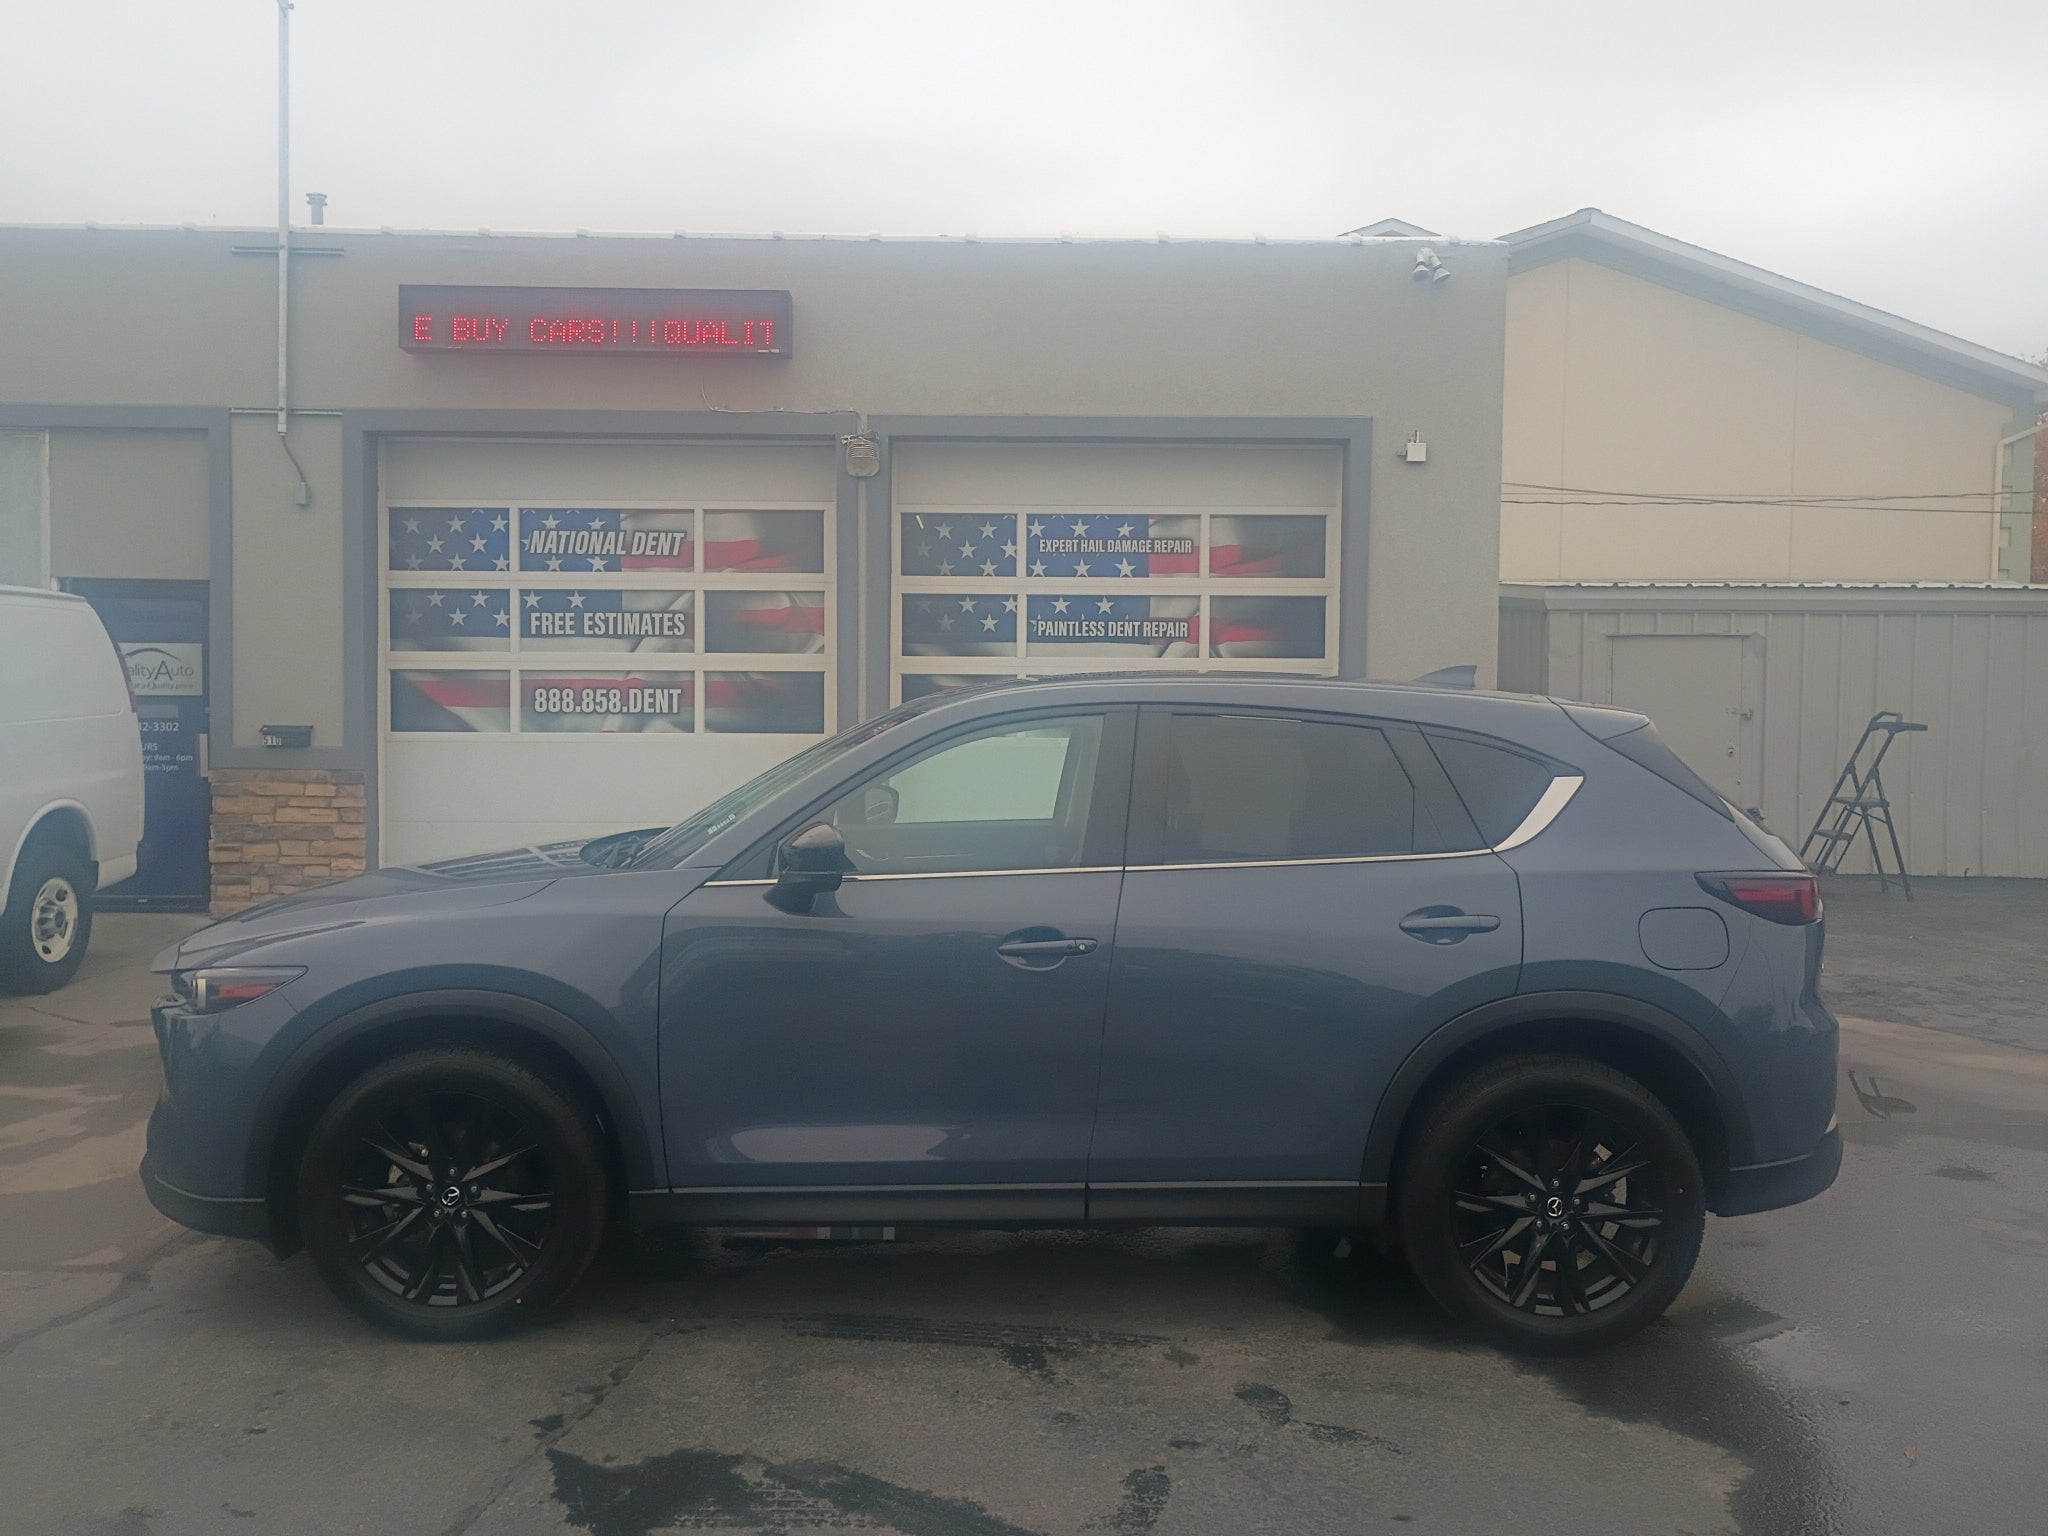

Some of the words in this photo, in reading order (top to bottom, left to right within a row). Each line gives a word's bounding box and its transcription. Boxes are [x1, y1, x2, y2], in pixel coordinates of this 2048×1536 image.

[414, 316, 432, 341] E
[452, 317, 509, 342] BUY
[530, 530, 627, 555] NATIONAL
[630, 532, 685, 556] DENT
[1039, 539, 1078, 553] EXPERT
[1081, 540, 1105, 553] HAIL
[1107, 540, 1151, 553] DAMAGE
[1154, 540, 1192, 553] REPAIR
[530, 612, 576, 635] FREE
[583, 612, 686, 636] ESTIMATES
[1038, 621, 1105, 637] PAINTLESS
[1108, 622, 1140, 637] DENT
[1143, 622, 1188, 637] REPAIR
[128, 660, 194, 681] alityAuto
[534, 688, 682, 714] 888.858.DENT
[142, 743, 158, 751] URS
